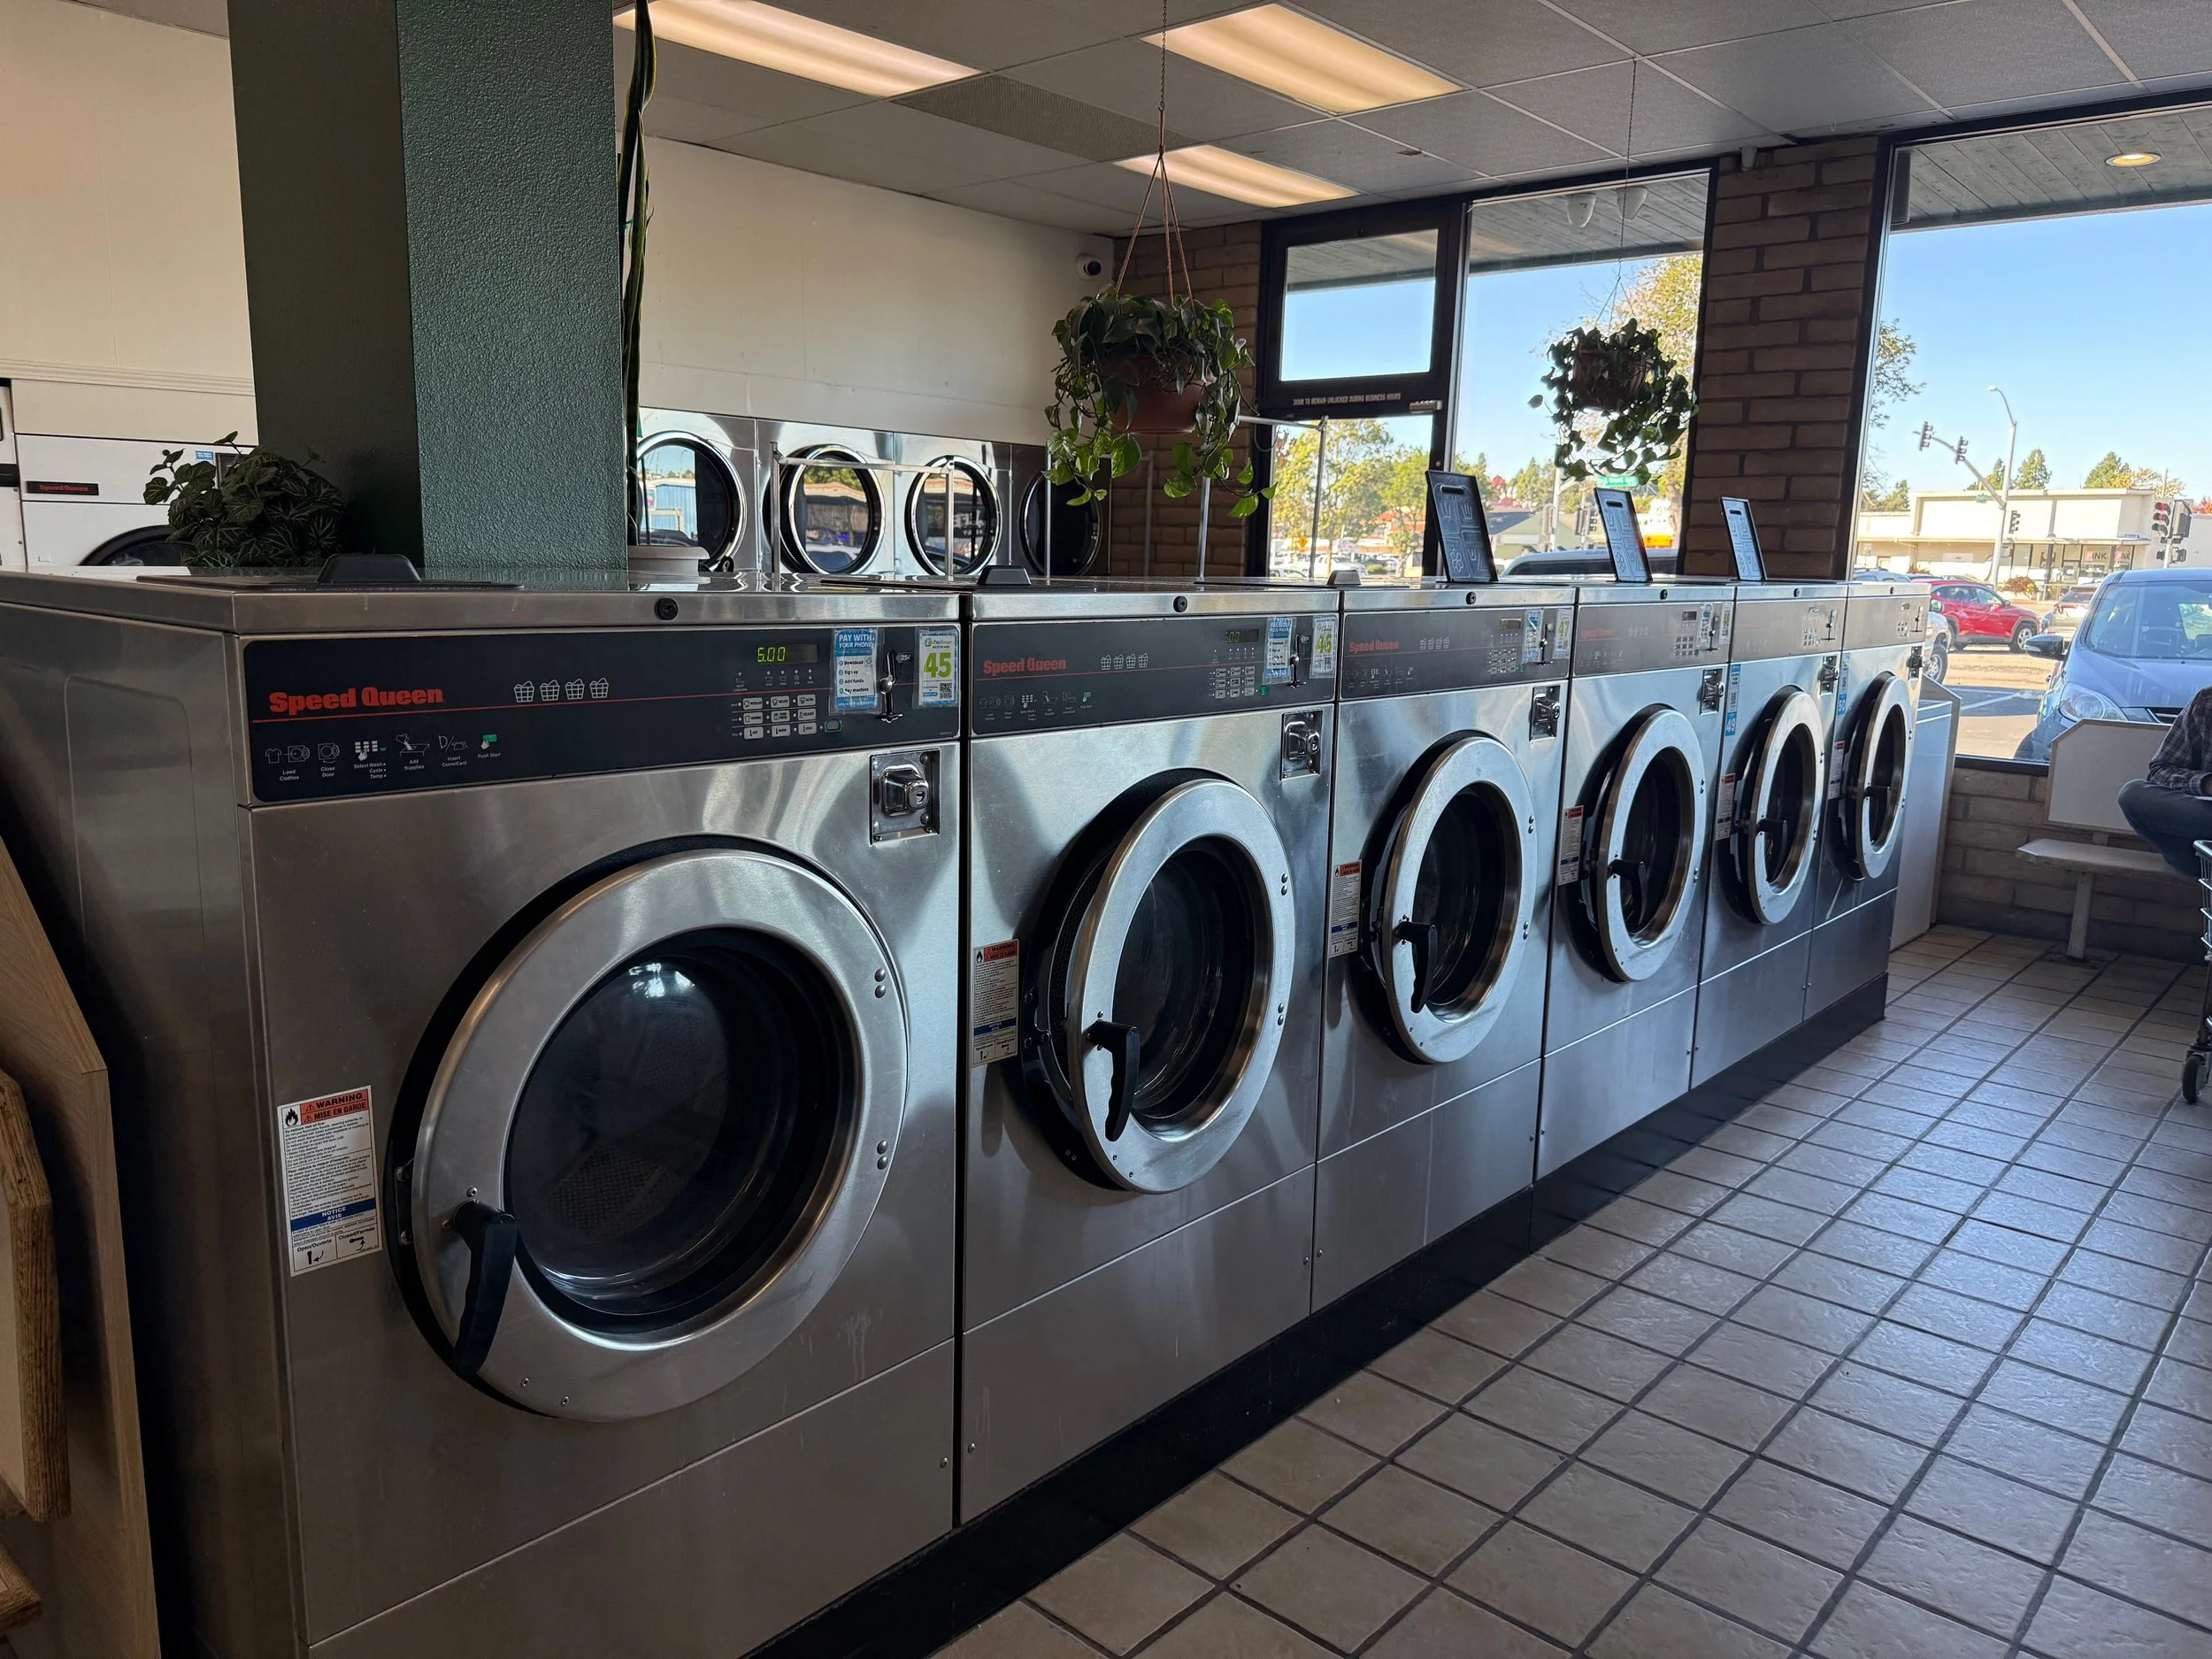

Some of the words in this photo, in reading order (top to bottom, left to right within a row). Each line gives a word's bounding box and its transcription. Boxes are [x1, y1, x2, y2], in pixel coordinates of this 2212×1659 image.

[1317, 634, 1333, 654] 46
[1349, 640, 1373, 654] Speed
[1375, 639, 1399, 651] Queen
[924, 652, 952, 678] 45
[983, 658, 1025, 676] Speed
[1027, 657, 1066, 671] Queen
[269, 687, 356, 716] Speed
[361, 687, 442, 706] Queen
[991, 943, 1014, 952] WARNING
[316, 1092, 362, 1109] WARNING
[313, 1110, 331, 1119] MISE
[343, 1102, 365, 1112] GARDE
[321, 1206, 346, 1217] NOTICE
[326, 1212, 342, 1221] AVIS
[296, 1238, 332, 1252] Open/Ouverte
